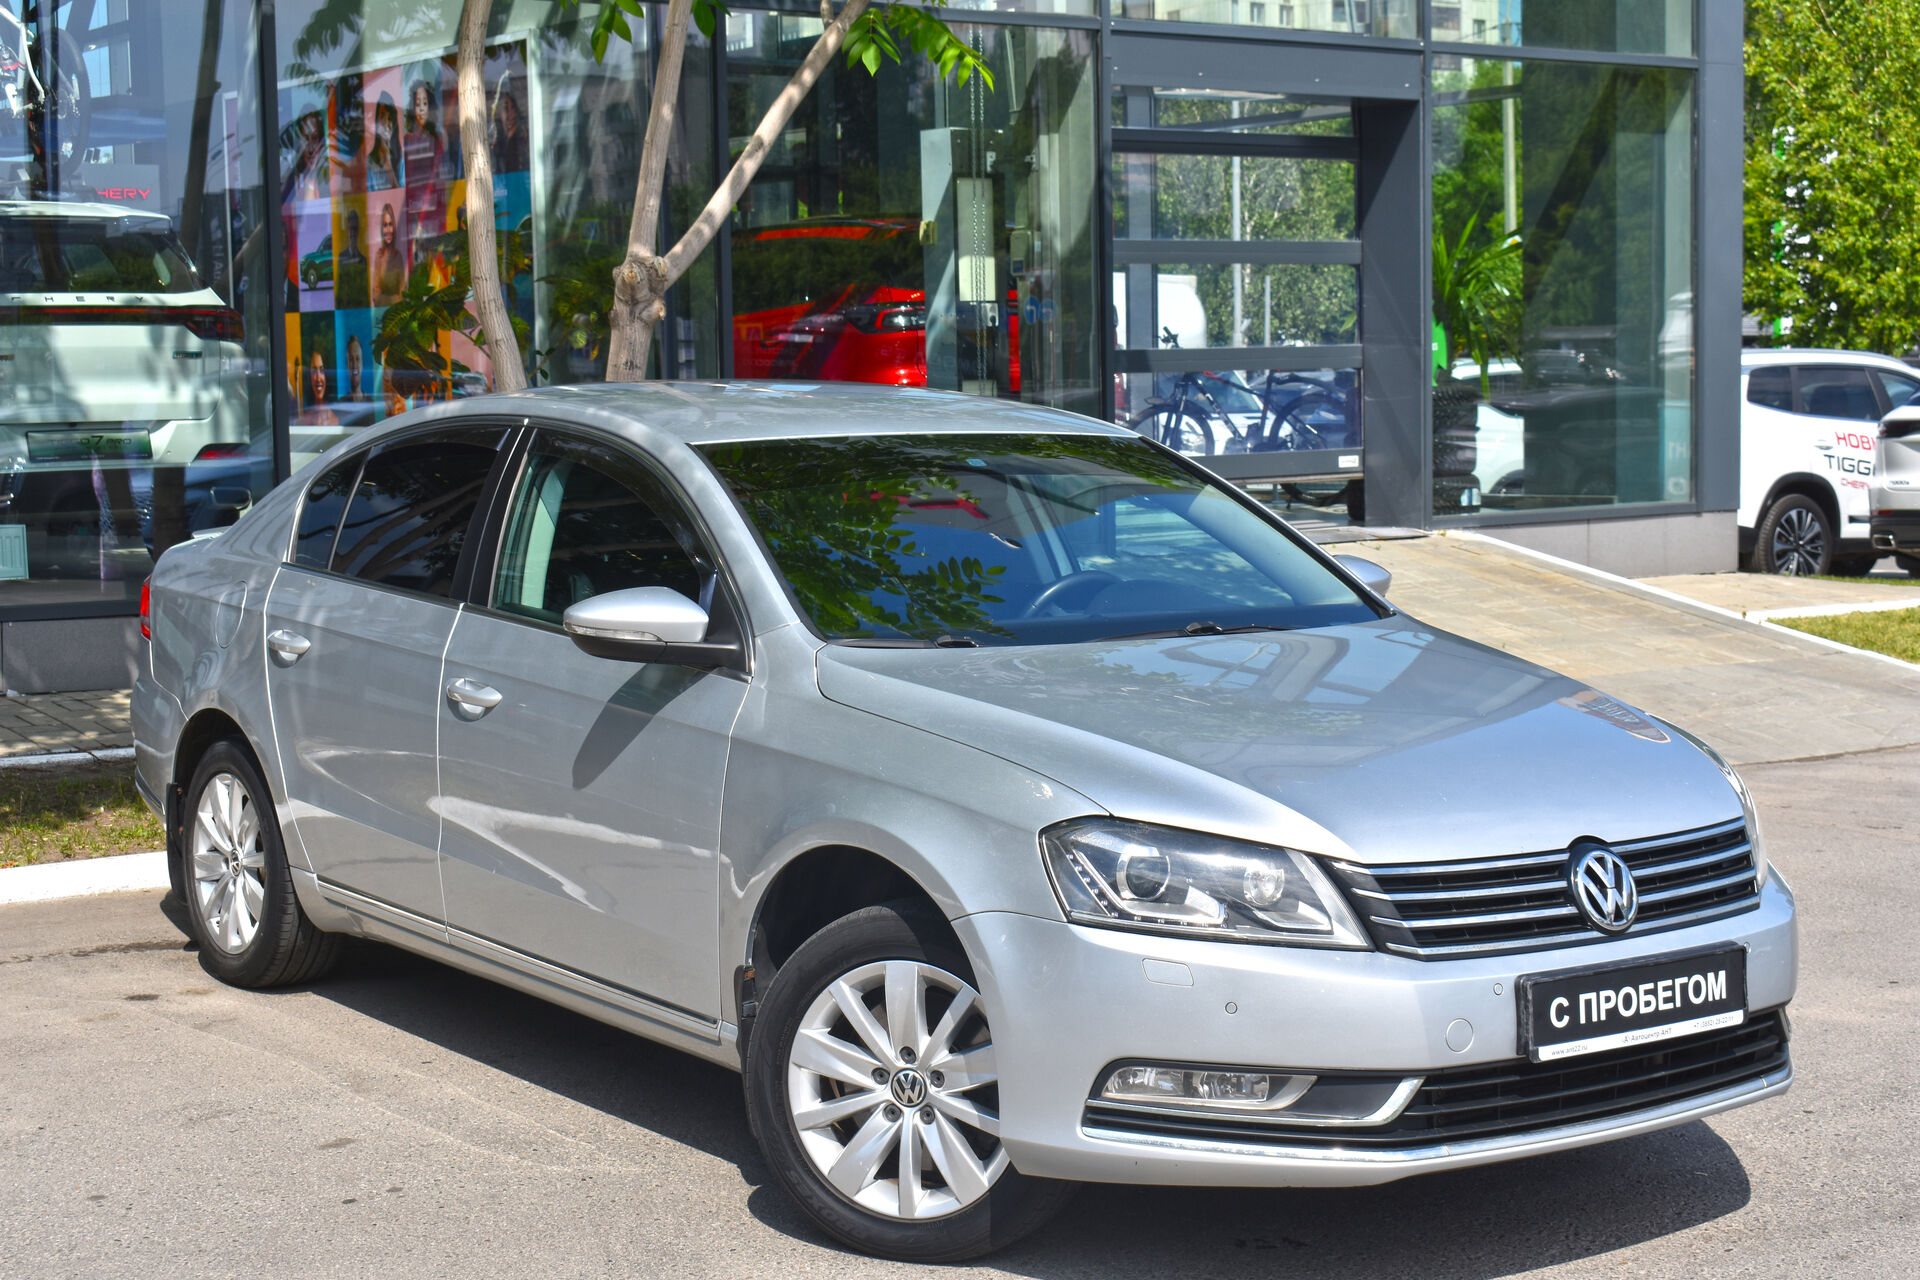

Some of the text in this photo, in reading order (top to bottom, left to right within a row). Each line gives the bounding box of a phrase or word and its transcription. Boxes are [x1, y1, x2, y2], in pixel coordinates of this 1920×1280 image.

[95, 187, 151, 200] HERY
[1823, 454, 1876, 476] TIGG
[1549, 970, 1727, 1029] С ПРОБЕГОМ
